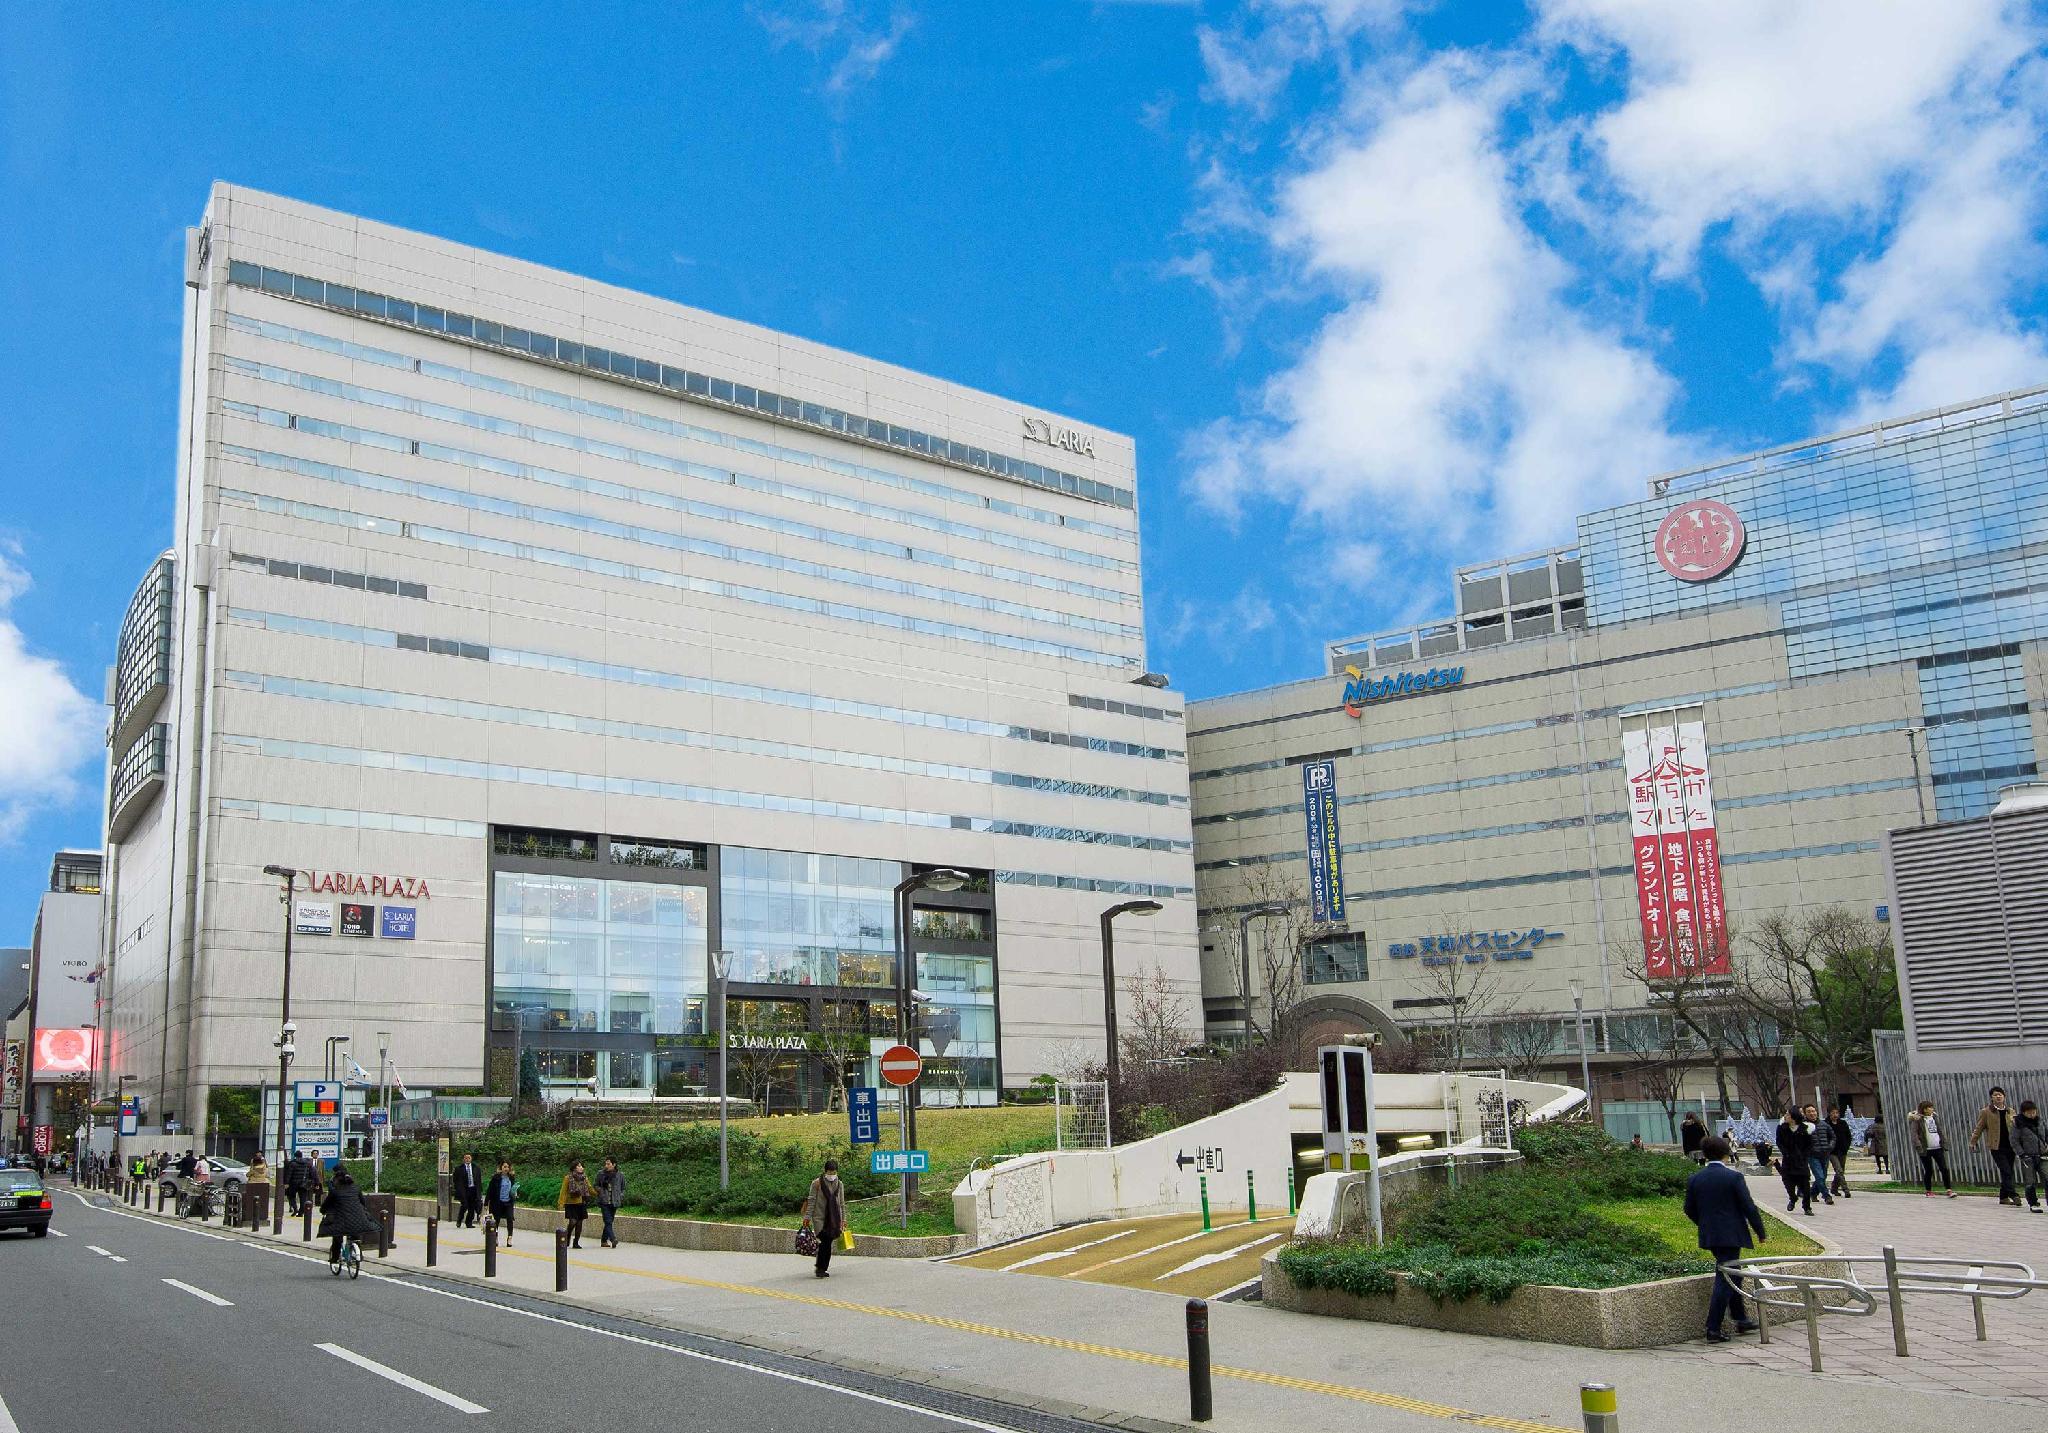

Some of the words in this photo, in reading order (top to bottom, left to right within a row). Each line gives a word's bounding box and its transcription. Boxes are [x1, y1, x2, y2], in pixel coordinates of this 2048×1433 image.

[1022, 418, 1095, 460] SOLARIA
[1342, 664, 1464, 705] Nishitetsu
[1636, 805, 1708, 827] マルシェ
[1667, 842, 1689, 902] 地下2階
[371, 876, 430, 900] PLAZA
[384, 911, 415, 921] SOLARIA
[1639, 845, 1666, 968] グランドオープン
[729, 1033, 775, 1049] SOLARIA
[775, 1036, 808, 1050] PLAZA
[315, 1085, 326, 1097] P
[855, 1091, 872, 1140] 車出口
[875, 1154, 925, 1171] 出庫口
[1195, 1145, 1224, 1174] 出車口
